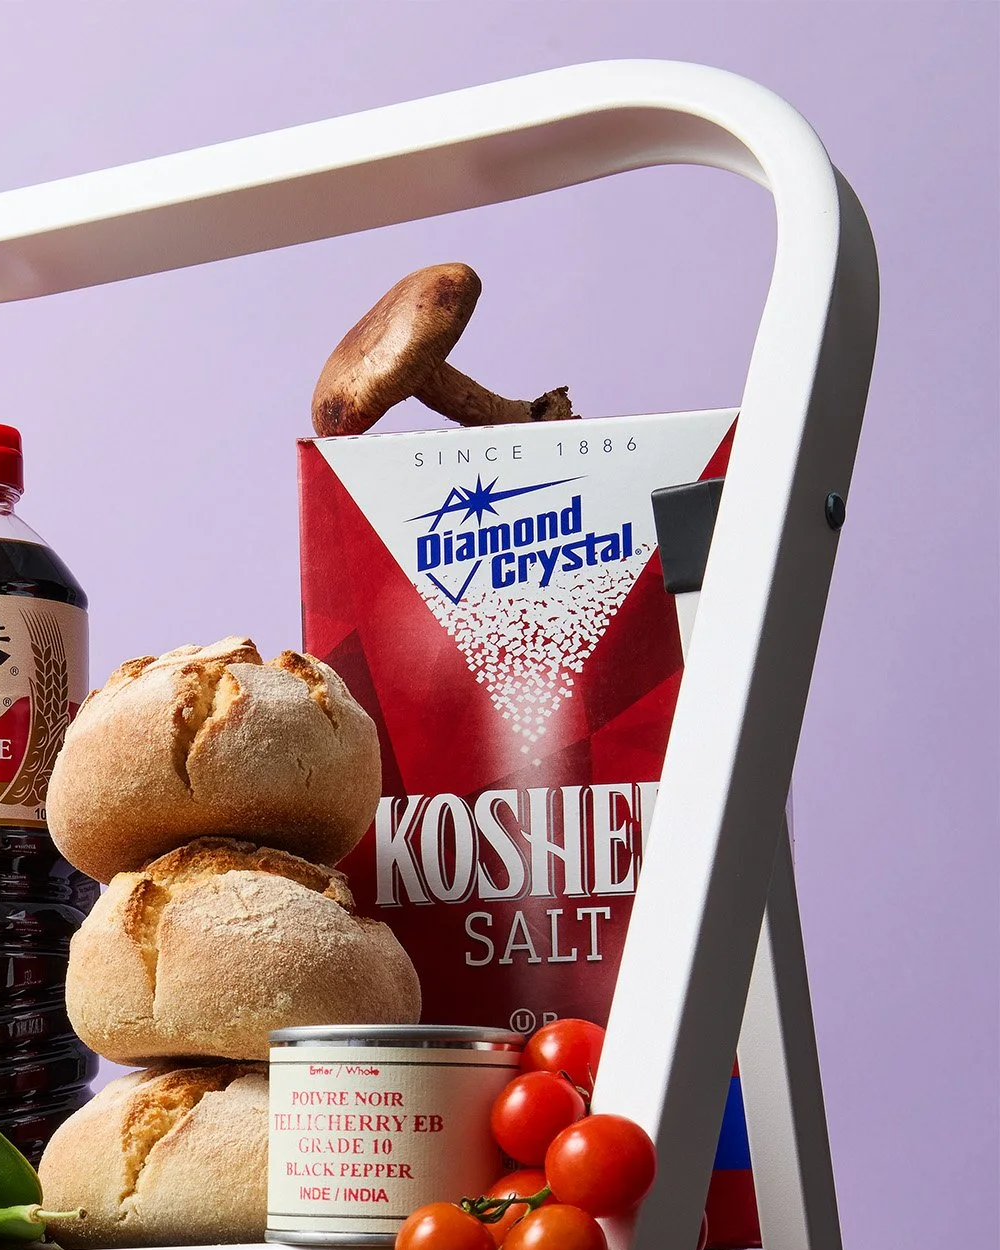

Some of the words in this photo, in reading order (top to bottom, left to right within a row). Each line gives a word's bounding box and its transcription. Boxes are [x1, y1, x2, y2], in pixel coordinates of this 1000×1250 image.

[414, 445, 523, 467] SINCE
[556, 436, 637, 456] 1886
[416, 494, 582, 573] Diamond
[491, 522, 633, 589] Crystal
[464, 906, 611, 967] SALT
[345, 1066, 380, 1077] Whole
[291, 1091, 349, 1106] POIVRE
[354, 1091, 405, 1107] NOIR
[273, 1113, 408, 1133] TELLICHERRY
[413, 1114, 444, 1133] EB
[298, 1137, 364, 1155] GRADE
[371, 1138, 393, 1155] 10
[286, 1162, 335, 1177] BLACK
[339, 1163, 414, 1179] PEPPER
[299, 1186, 331, 1201] INDE
[334, 1187, 340, 1201] /
[343, 1188, 389, 1203] INDIA
